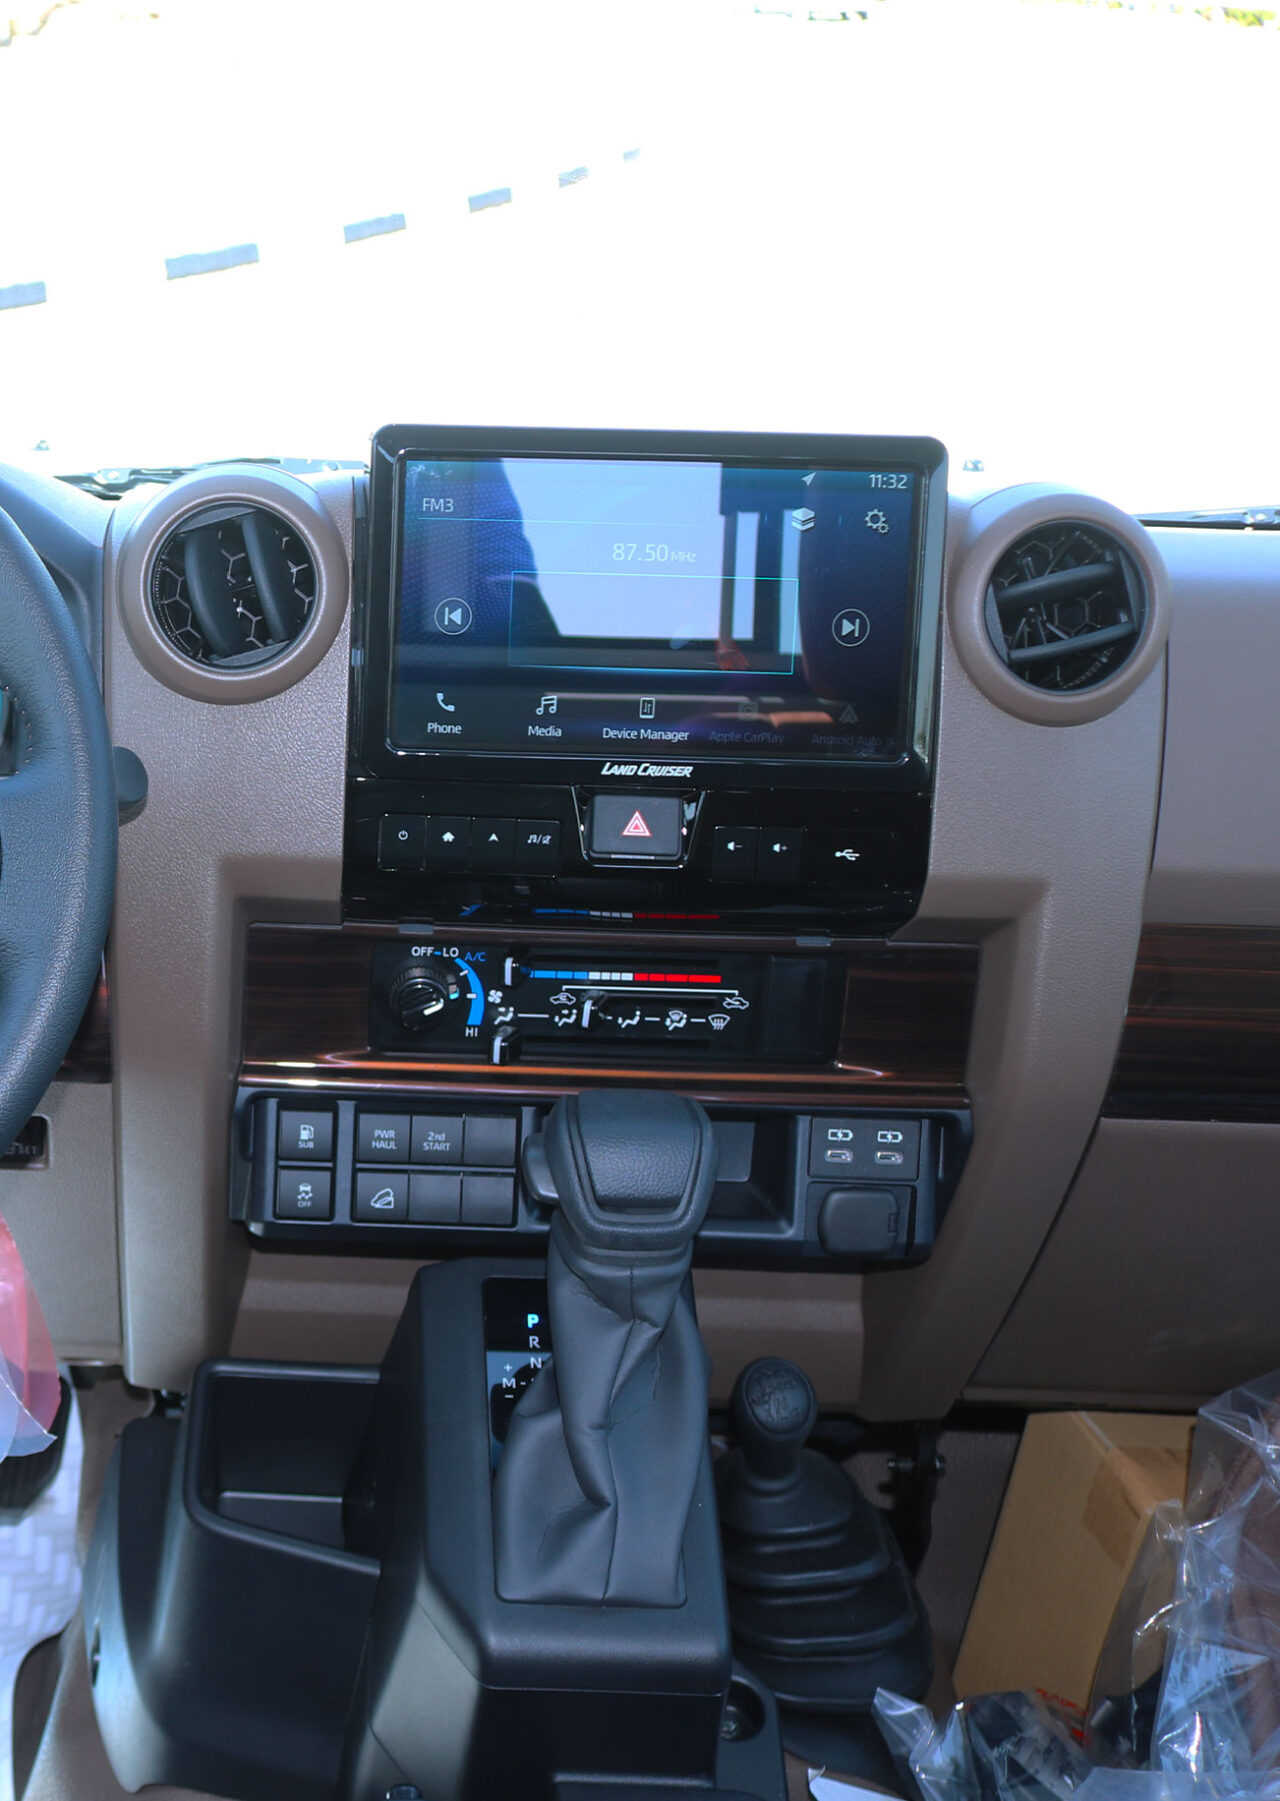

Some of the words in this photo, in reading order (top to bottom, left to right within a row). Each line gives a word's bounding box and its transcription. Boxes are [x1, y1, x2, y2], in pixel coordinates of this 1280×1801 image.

[869, 473, 908, 489] 11:32
[422, 498, 454, 512] FM3
[612, 543, 669, 562] 87.50
[671, 552, 697, 562] MHz
[427, 722, 462, 735] Phone
[528, 725, 562, 737] Media
[602, 727, 637, 740] Device
[640, 728, 690, 743] Manager
[709, 730, 742, 744] Apple
[743, 731, 785, 745] CarPlay
[601, 762, 639, 776] LAND
[637, 762, 694, 777] CRUISER
[411, 946, 434, 957] OFF
[442, 947, 460, 957] LO
[464, 952, 487, 962] A/C
[465, 1027, 479, 1037] HI
[374, 1129, 396, 1139] PWR
[427, 1131, 446, 1142] 2nd
[298, 1141, 314, 1149] SUB
[372, 1140, 397, 1150] HAUL
[423, 1142, 451, 1151] START
[297, 1200, 312, 1208] OFF
[527, 1313, 540, 1329] P
[529, 1335, 541, 1349] R
[530, 1356, 543, 1369] N
[502, 1377, 517, 1389] M
